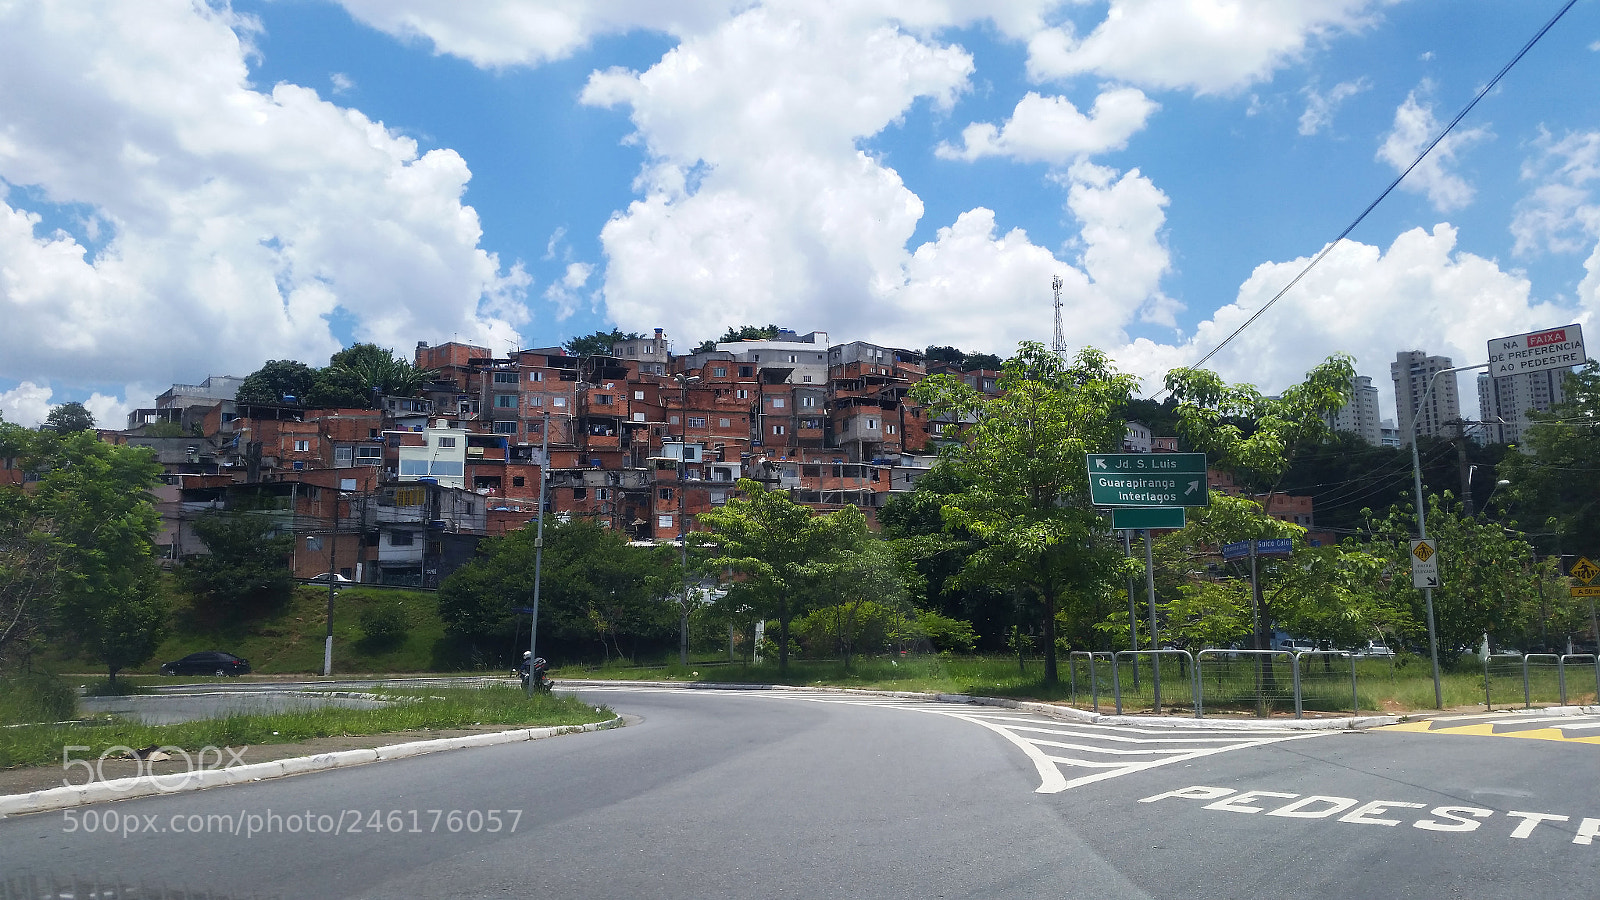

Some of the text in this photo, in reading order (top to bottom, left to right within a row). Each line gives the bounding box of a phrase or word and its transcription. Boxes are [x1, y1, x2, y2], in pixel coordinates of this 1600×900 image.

[1503, 333, 1562, 350] NA FAIXA
[1508, 340, 1582, 360] PREFERÊNCIA
[1500, 352, 1577, 372] AO PEDESTRE
[1115, 459, 1177, 469] Jd. S. Luis
[1099, 478, 1176, 490] Guarapiranga
[1118, 491, 1176, 504] Interlagos
